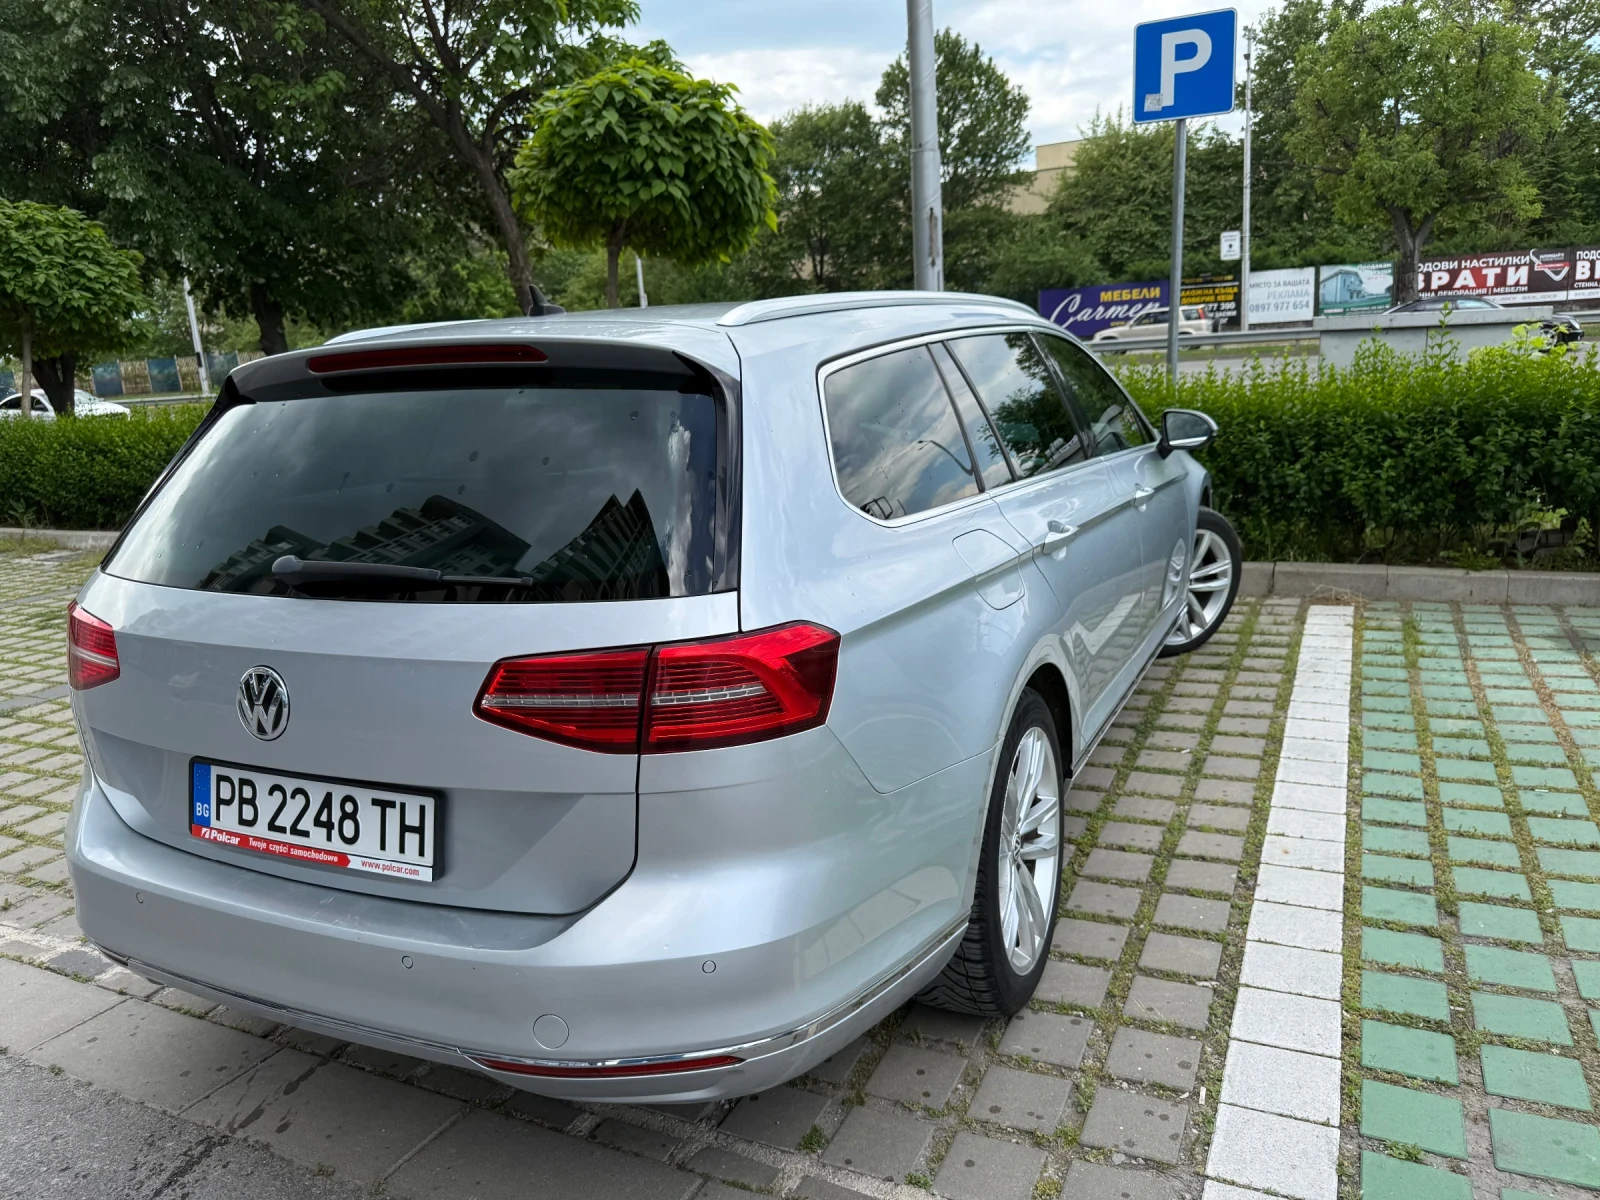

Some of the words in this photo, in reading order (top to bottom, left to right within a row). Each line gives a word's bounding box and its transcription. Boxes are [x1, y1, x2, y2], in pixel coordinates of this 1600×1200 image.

[1160, 28, 1212, 107] P
[1418, 260, 1458, 273] ОДОВИ
[1461, 255, 1530, 269] НАСТИЛКИ
[1283, 278, 1310, 287] ВАШАТА
[1493, 285, 1529, 294] МЕБЕЛИ
[1574, 281, 1598, 289] СТЕННА
[1100, 287, 1161, 302] МЕБЕЛИ
[1181, 289, 1213, 297] АЛОЖНА
[1267, 289, 1309, 300] РЕКЛАМА
[1249, 303, 1270, 313] 0897
[1273, 302, 1290, 312] 977
[1292, 300, 1309, 310] 654
[196, 801, 210, 818] BG
[215, 774, 259, 827] PB
[267, 783, 360, 845] 2248
[371, 797, 426, 858] TH
[210, 829, 241, 845] Polcar
[249, 837, 267, 850] Twoje
[269, 843, 288, 854] części
[290, 848, 338, 862] samochodowe
[361, 859, 420, 877] www.polcar.com
